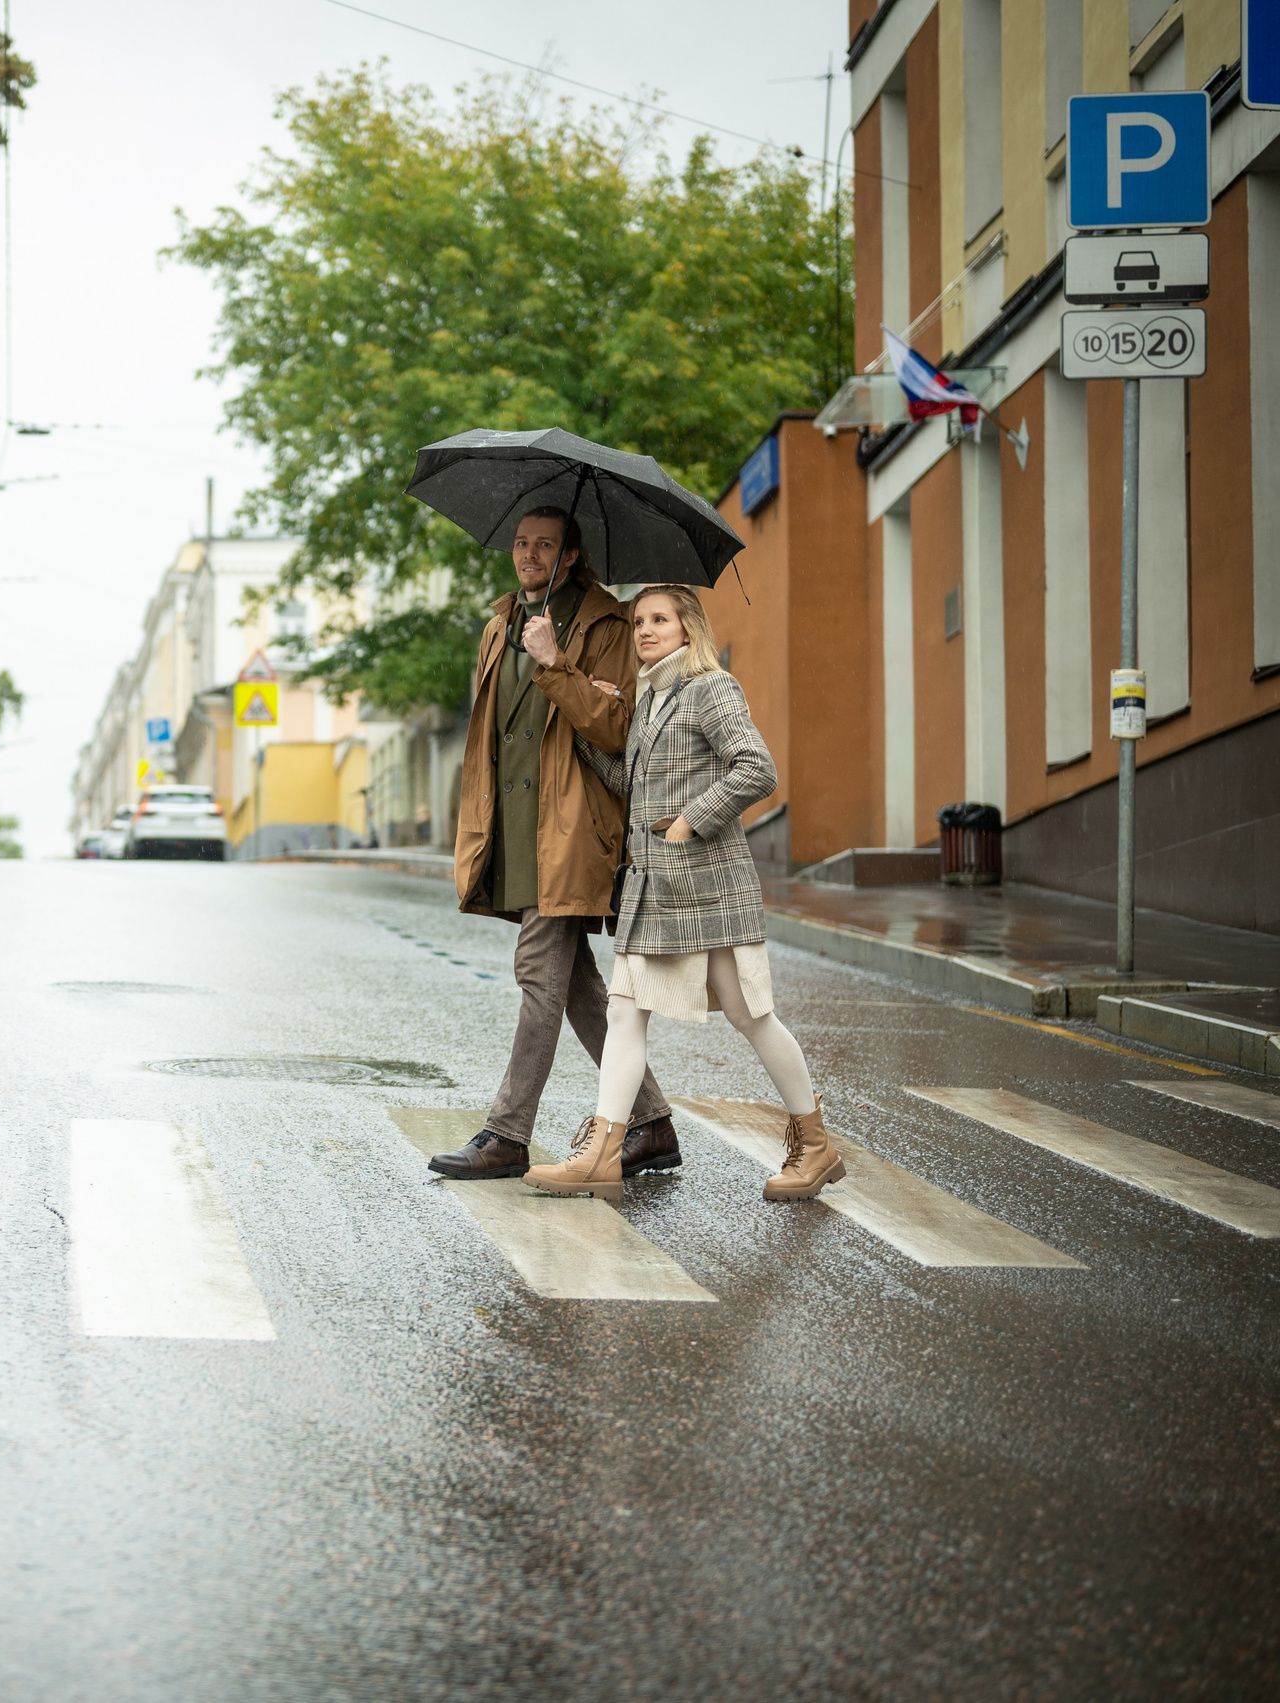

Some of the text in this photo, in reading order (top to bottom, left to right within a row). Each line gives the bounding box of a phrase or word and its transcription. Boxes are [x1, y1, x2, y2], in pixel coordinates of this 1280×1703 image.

[1106, 111, 1177, 209] P
[1081, 328, 1188, 357] 10 15 20
